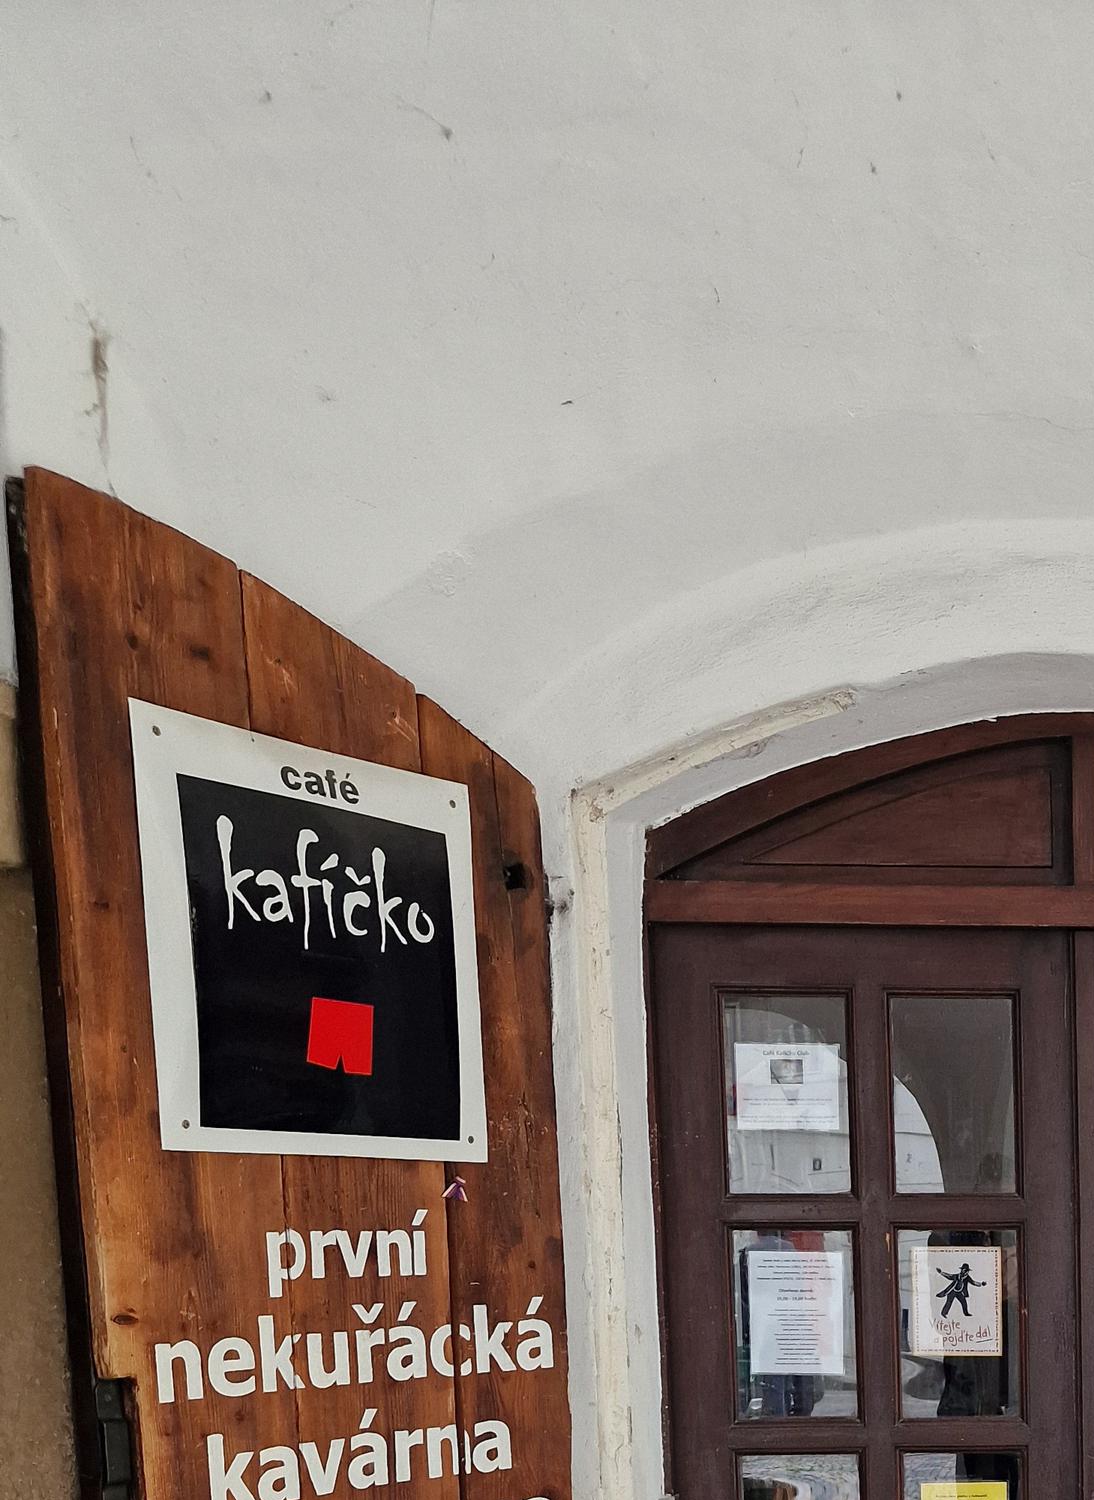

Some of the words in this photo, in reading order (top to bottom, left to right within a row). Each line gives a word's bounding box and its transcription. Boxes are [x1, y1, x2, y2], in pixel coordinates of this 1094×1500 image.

[280, 763, 360, 804] café
[216, 815, 435, 953] kafíčko
[266, 1209, 428, 1297] první
[154, 1296, 555, 1404] nekuřácká
[943, 1330, 974, 1347] pojďte
[975, 1325, 992, 1339] dál
